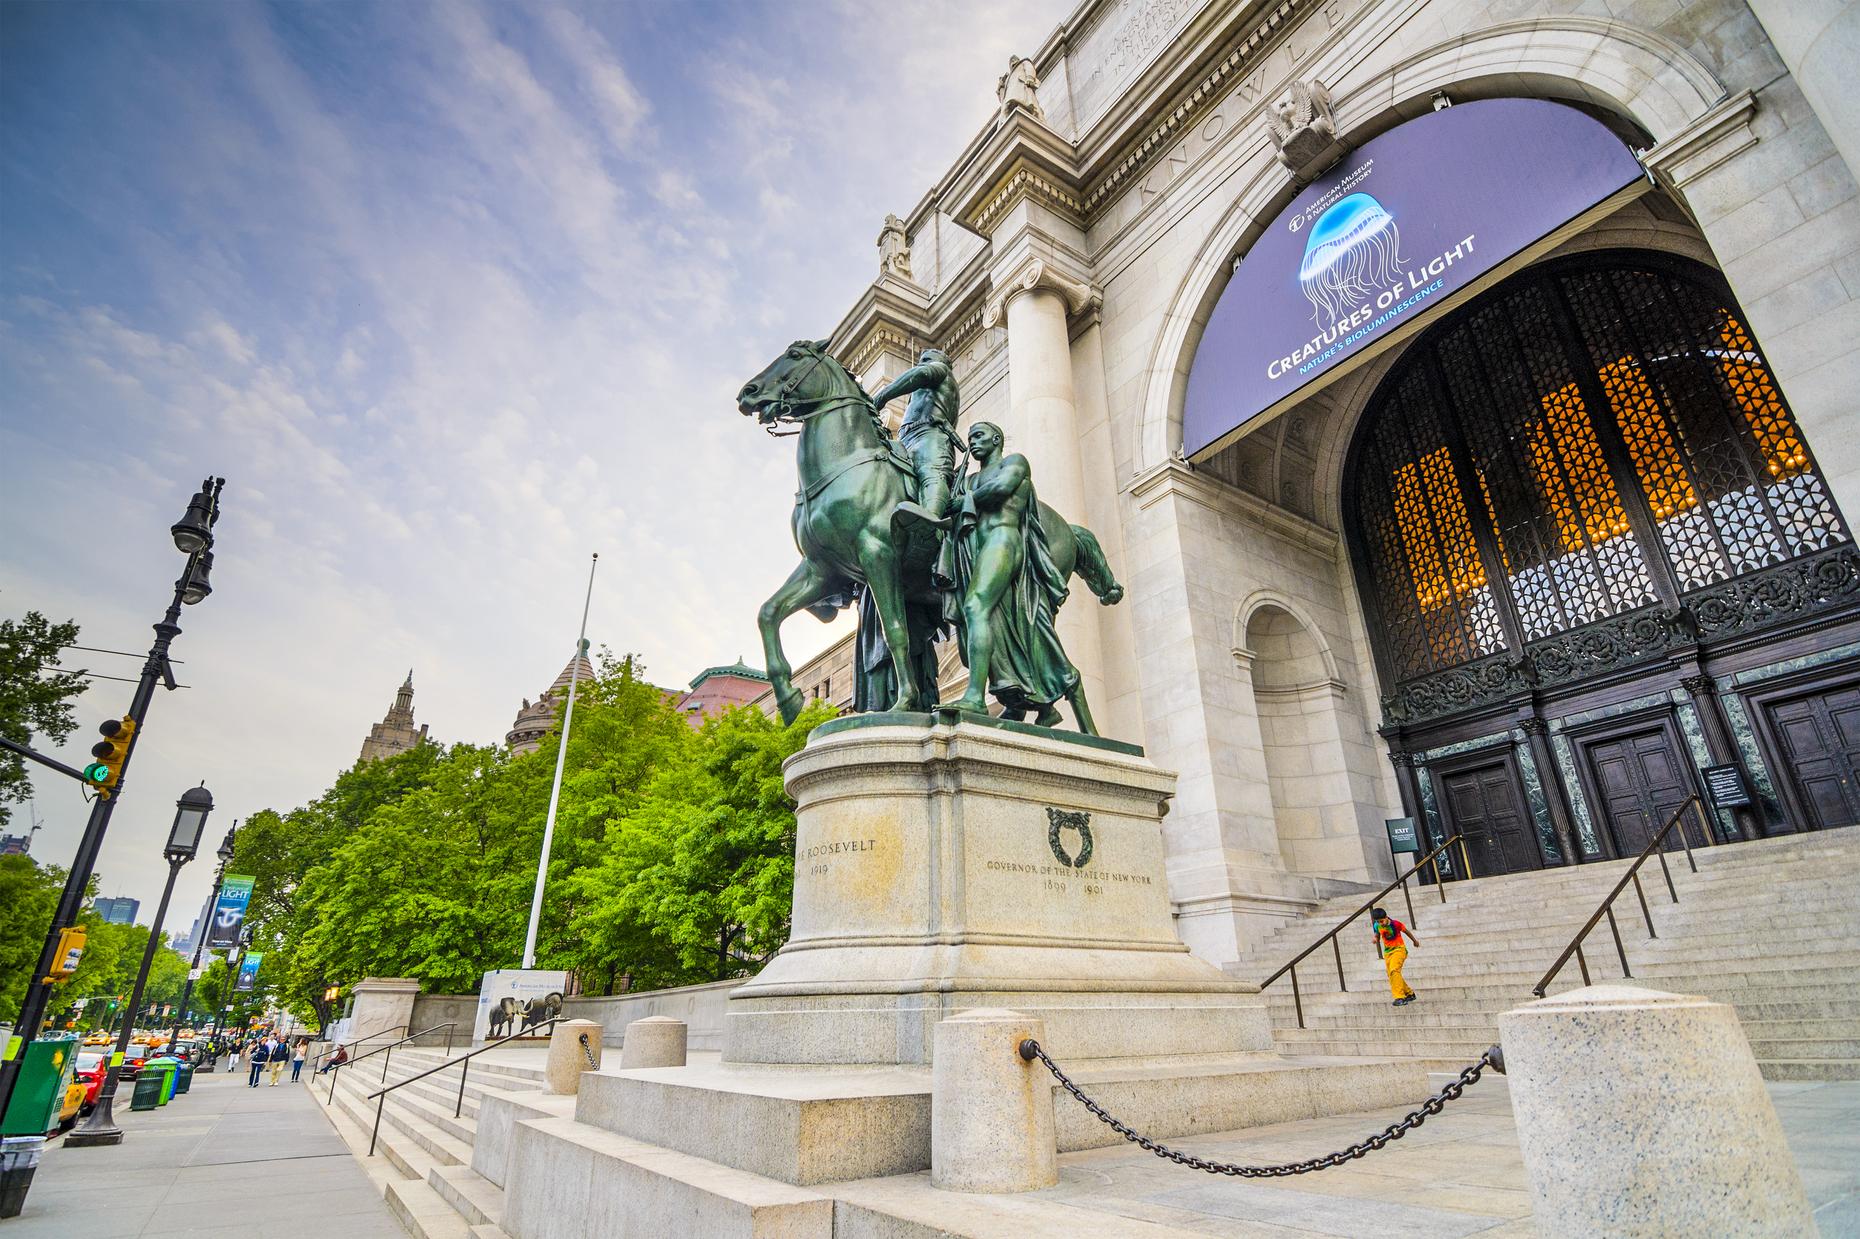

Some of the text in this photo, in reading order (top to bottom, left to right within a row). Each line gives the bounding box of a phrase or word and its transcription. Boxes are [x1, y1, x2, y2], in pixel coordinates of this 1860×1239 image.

[1305, 159, 1374, 215] AMERICAN MUSEUM
[1312, 192, 1344, 218] NATURAL
[1343, 168, 1373, 193] HISTORY
[1267, 234, 1476, 380] CREATURES OF LIGHT
[1299, 278, 1444, 376] NATURE'S BIOLUMINESCENCE
[807, 840, 876, 859] ROOSEVELT
[811, 864, 828, 875] 1919
[987, 861, 1038, 874] GOVERNOR
[1054, 867, 1072, 877] THE
[1075, 870, 1099, 880] STATE
[1112, 873, 1129, 882] NEW
[1130, 875, 1152, 885] YORK
[222, 889, 250, 899] LIGHT
